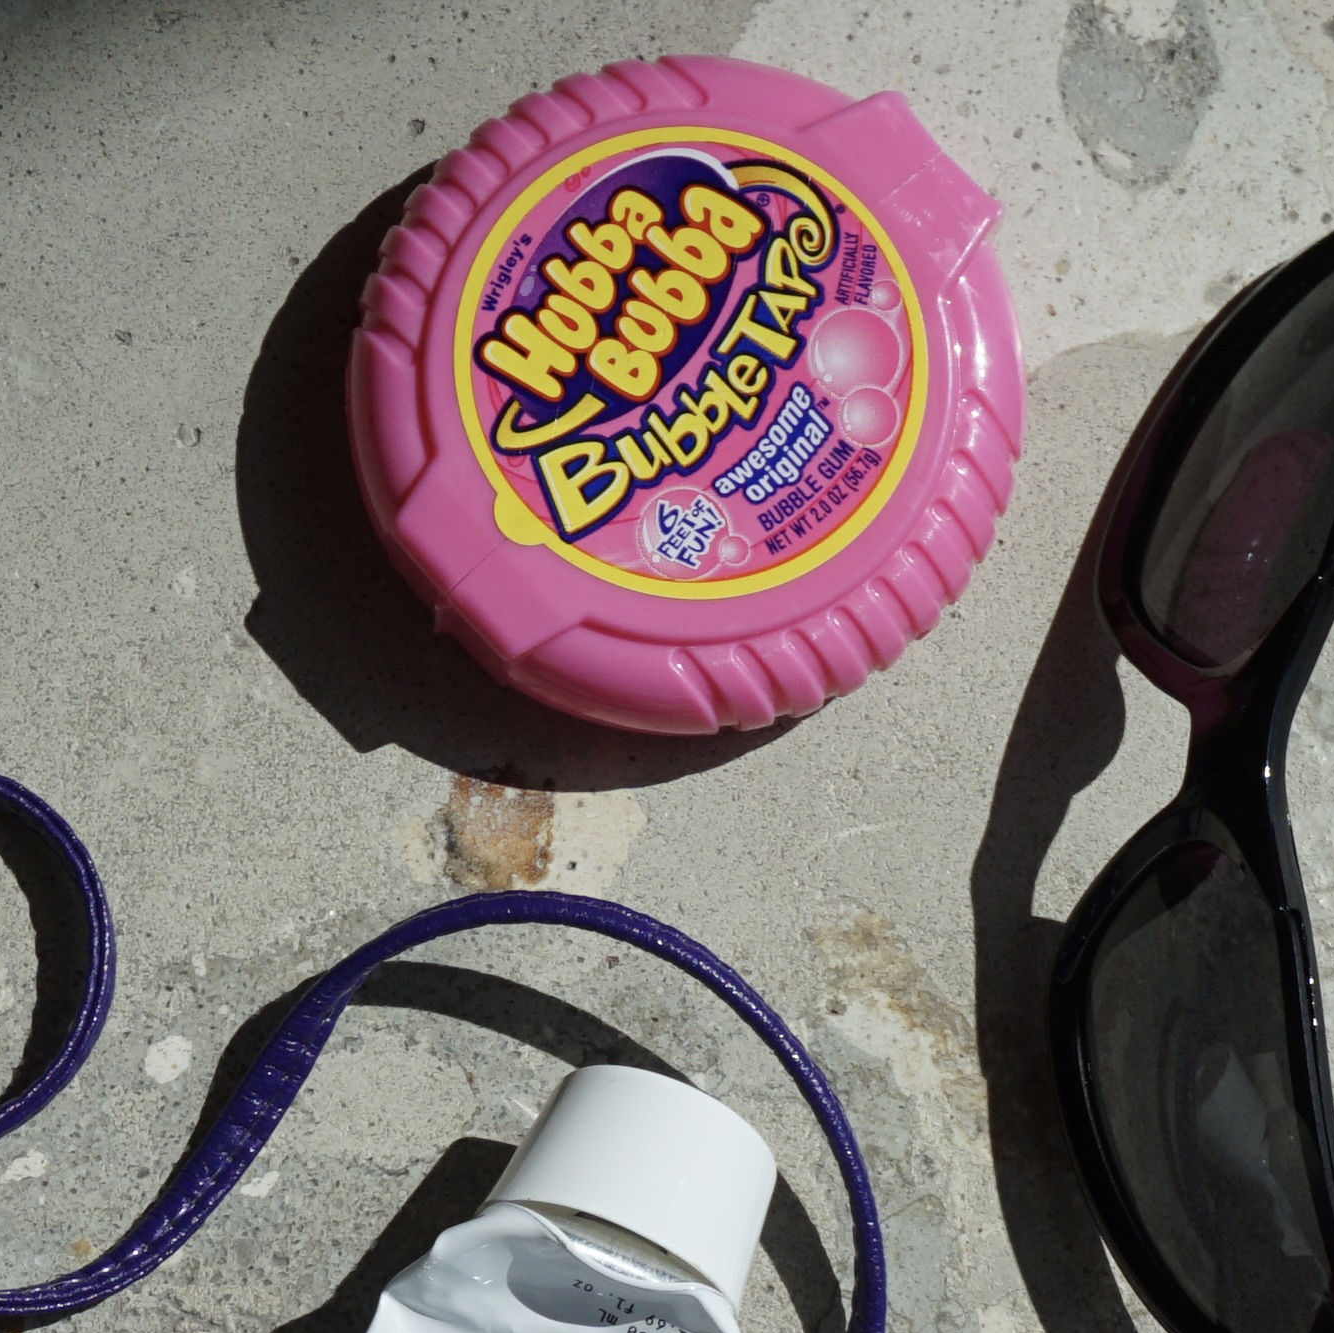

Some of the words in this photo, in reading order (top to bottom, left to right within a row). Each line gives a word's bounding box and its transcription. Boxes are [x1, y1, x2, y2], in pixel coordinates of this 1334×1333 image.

[481, 233, 533, 313] Wrigley's
[481, 188, 665, 403] Hubba
[586, 184, 766, 402] Bubba
[834, 232, 859, 305] ARTIFICIALLY
[854, 244, 877, 305] FLAVORED
[714, 386, 810, 494] awesome
[745, 409, 830, 502] original
[658, 503, 679, 536] 6
[757, 475, 823, 532] BUBBLE
[818, 439, 856, 480] GUM
[764, 531, 791, 556] NET
[789, 516, 813, 539] WT
[810, 500, 832, 523] 2.0
[831, 486, 848, 507] OZ
[842, 447, 882, 492] (56.7g)
[657, 513, 695, 558] FEET
[692, 499, 708, 518] OF
[677, 508, 720, 567] FUN!
[573, 1279, 593, 1292] oz
[599, 1308, 619, 1326] mL
